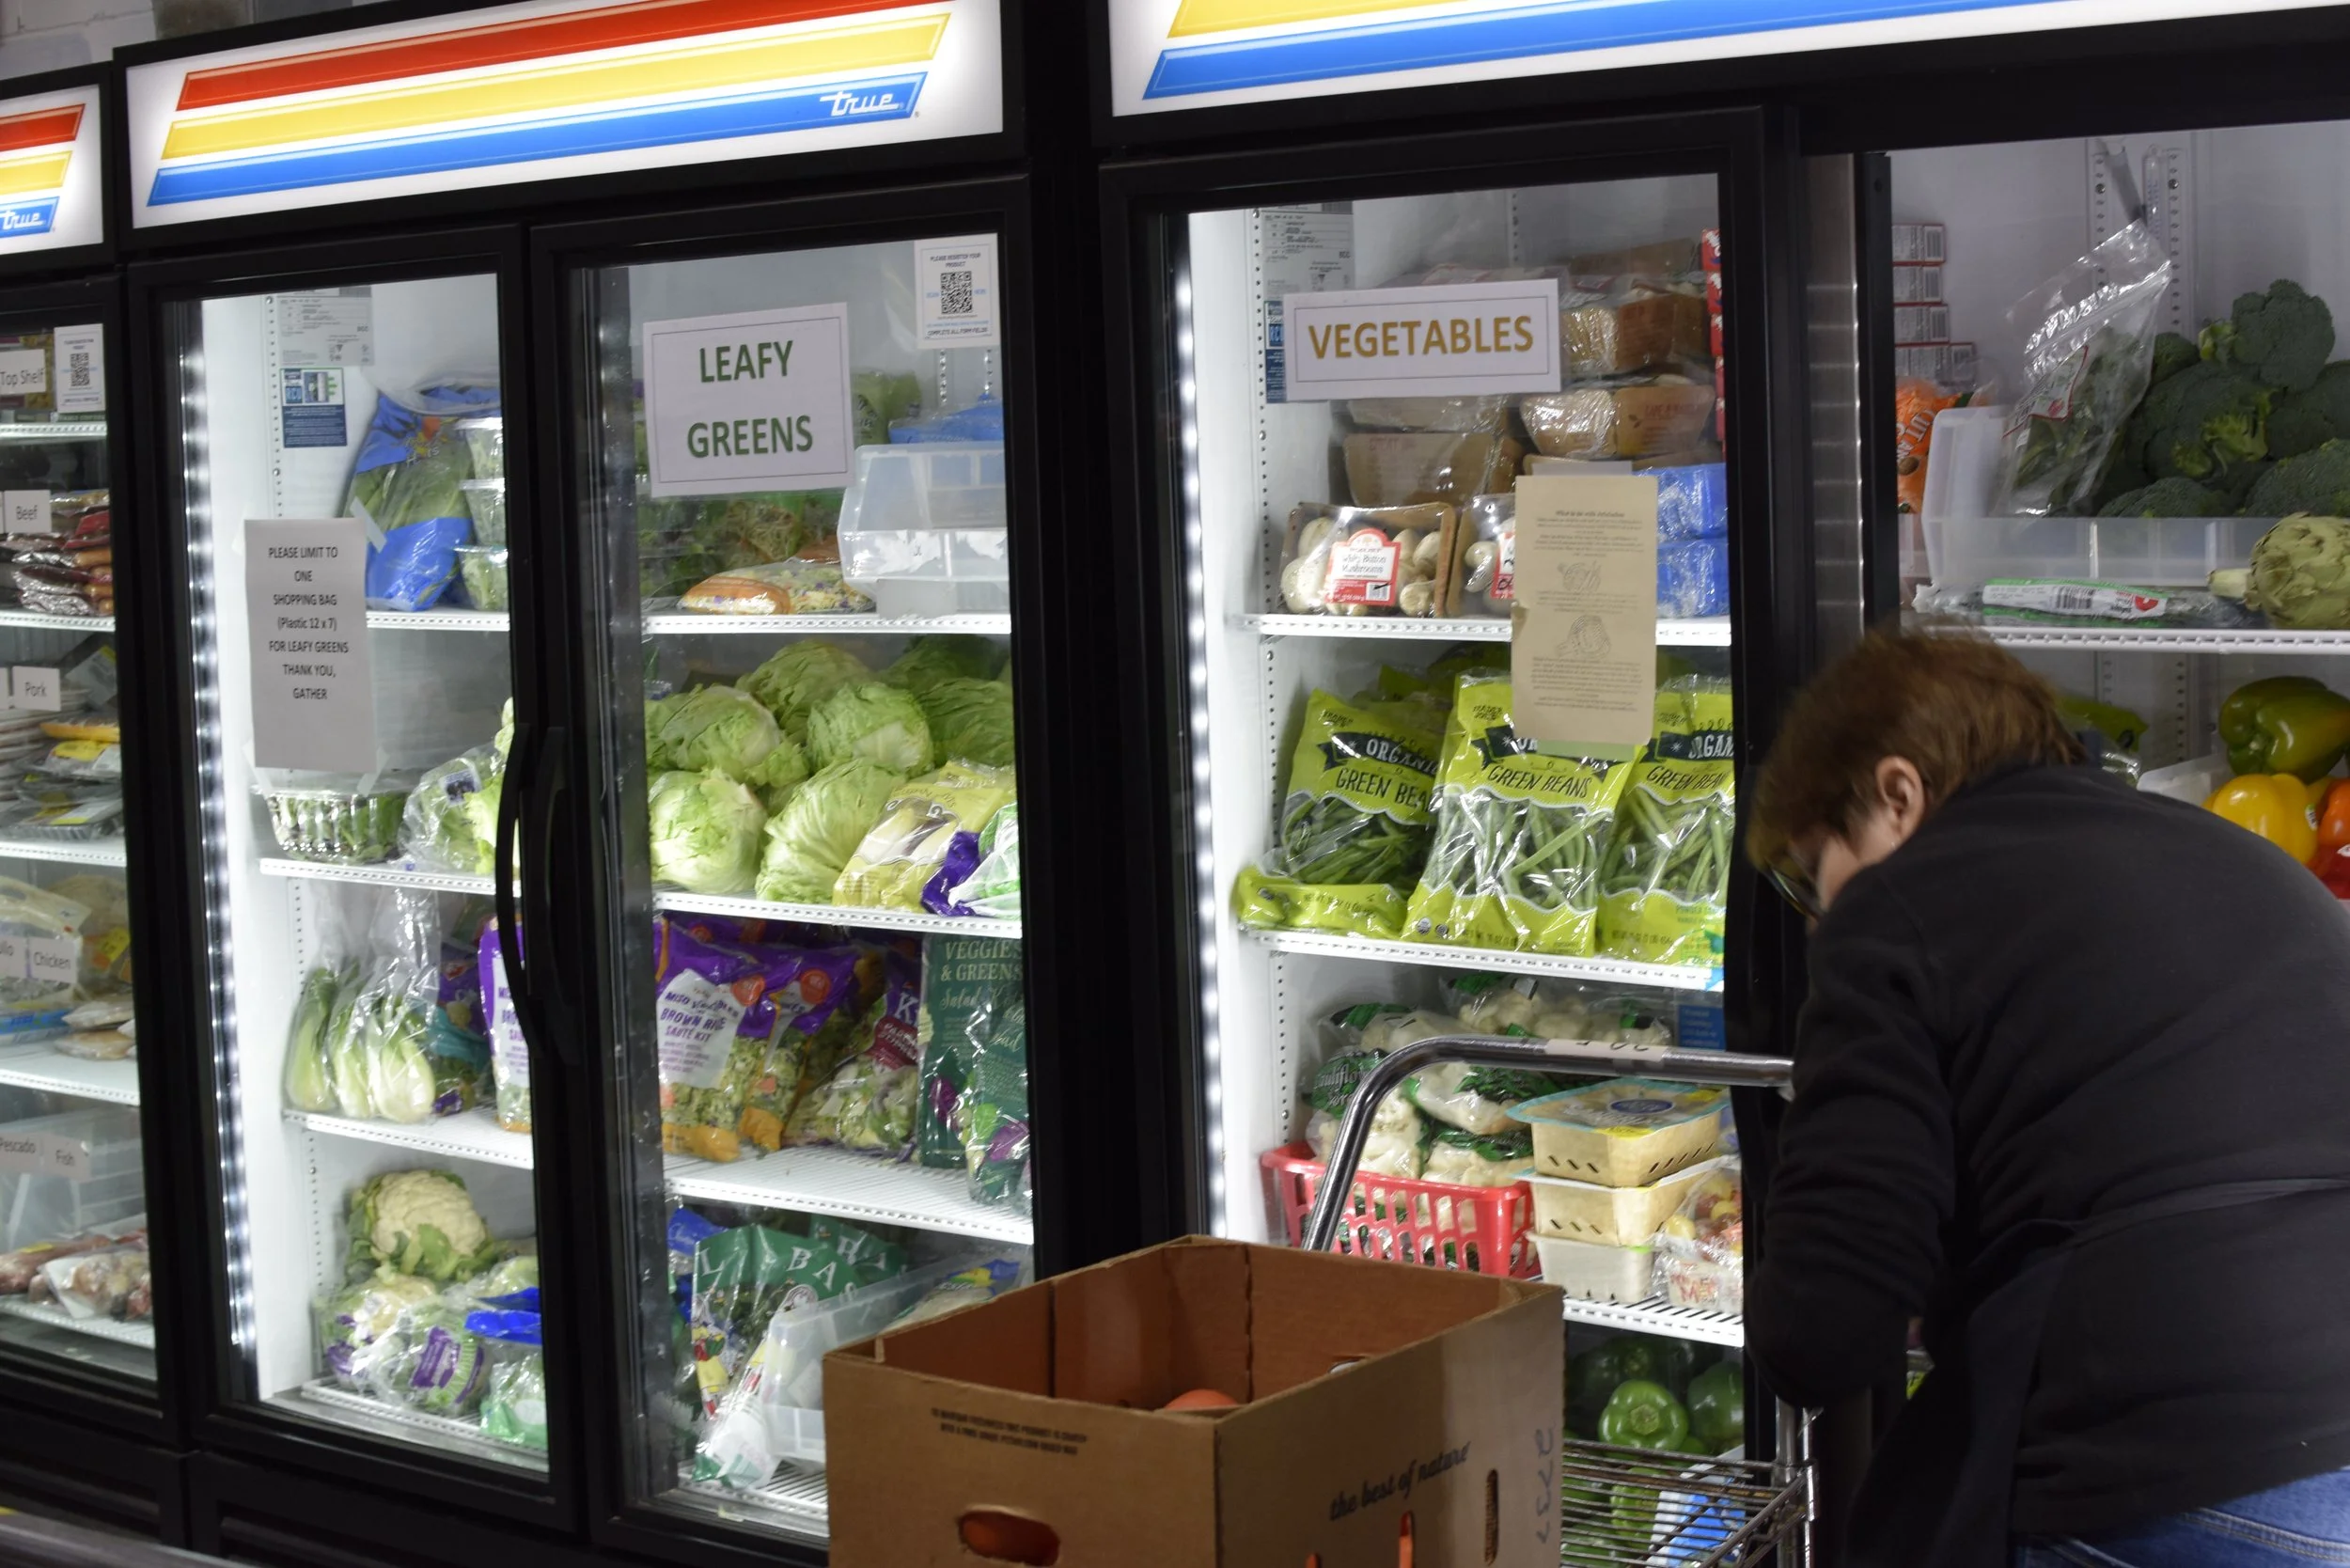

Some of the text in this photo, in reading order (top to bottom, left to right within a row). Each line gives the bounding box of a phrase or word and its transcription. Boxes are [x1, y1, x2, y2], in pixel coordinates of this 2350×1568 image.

[1308, 315, 1534, 359] VEGETABLES
[699, 340, 793, 384] LEAFY
[0, 368, 45, 386] Top Shelf
[687, 415, 813, 459] GREENS
[16, 505, 38, 521] Beef
[268, 546, 338, 558] PLEASE LIMIT TO
[294, 570, 312, 582] ONE
[273, 594, 337, 606] SHOPPING BAG
[277, 617, 337, 632] (Plastic 12 x 7)
[269, 640, 349, 654] FOR LEAFY GREENS
[282, 664, 337, 678] THANK YOU,
[24, 682, 46, 698] Pork
[292, 687, 328, 700] GATHER
[1487, 765, 1592, 798] GREEN BEANS
[1646, 765, 1698, 790] GREEN
[1336, 766, 1430, 812] GREEN BEA
[34, 951, 71, 971] Chicken
[941, 963, 1023, 981] & GREENS
[660, 1008, 703, 1027] BROWN
[702, 1017, 728, 1031] RICE
[694, 1031, 712, 1043] KIT
[55, 1150, 75, 1167] Fish
[1329, 1440, 1472, 1522] the best of nature
